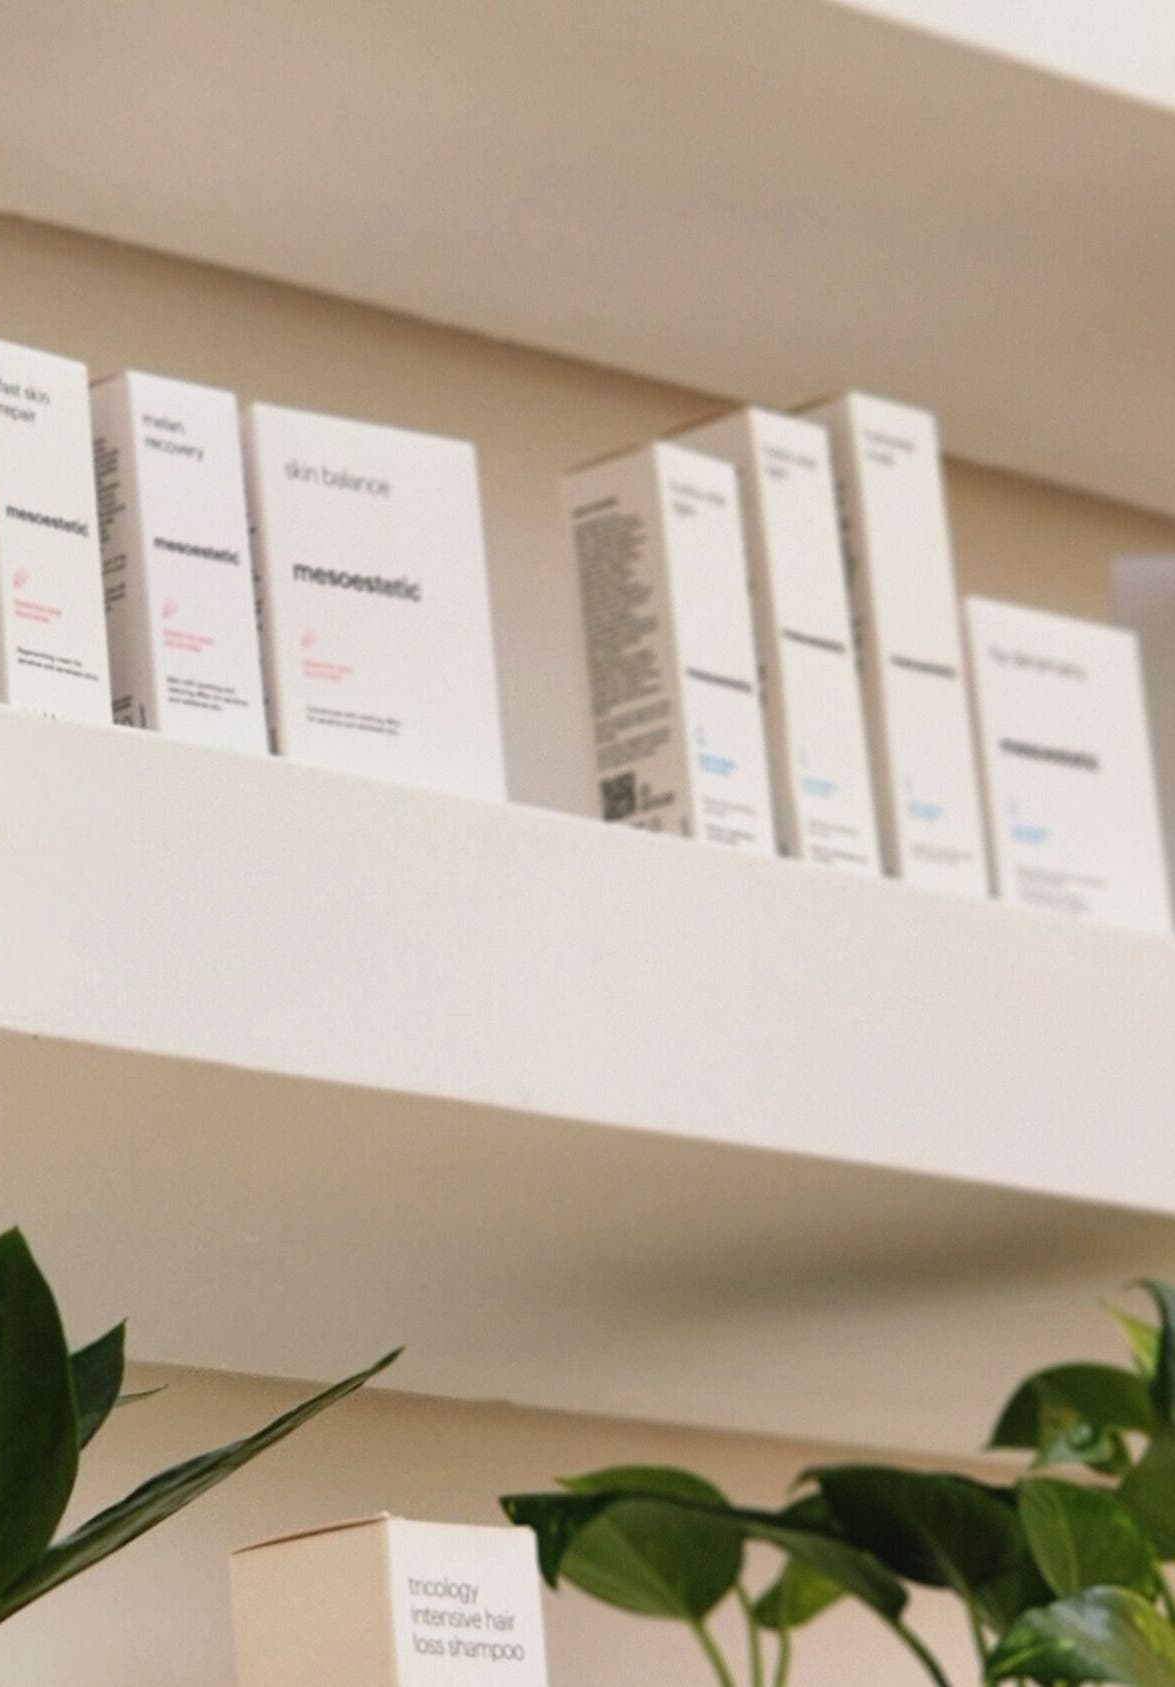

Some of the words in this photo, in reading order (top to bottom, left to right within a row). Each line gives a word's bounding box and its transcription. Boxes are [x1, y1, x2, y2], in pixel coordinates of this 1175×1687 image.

[23, 386, 50, 405] skin
[0, 401, 37, 424] repair
[143, 414, 184, 433] melan
[144, 434, 204, 462] recovery
[284, 460, 320, 483] skin
[323, 466, 391, 498] balance
[5, 505, 89, 538] mesoestetic
[153, 535, 240, 567] mesoestetic
[292, 562, 422, 603] mesoestetic
[408, 1577, 479, 1604] tricology
[411, 1607, 482, 1630] intensive
[485, 1608, 515, 1631] hair
[412, 1633, 445, 1656] loss
[447, 1636, 525, 1663] shampoo
